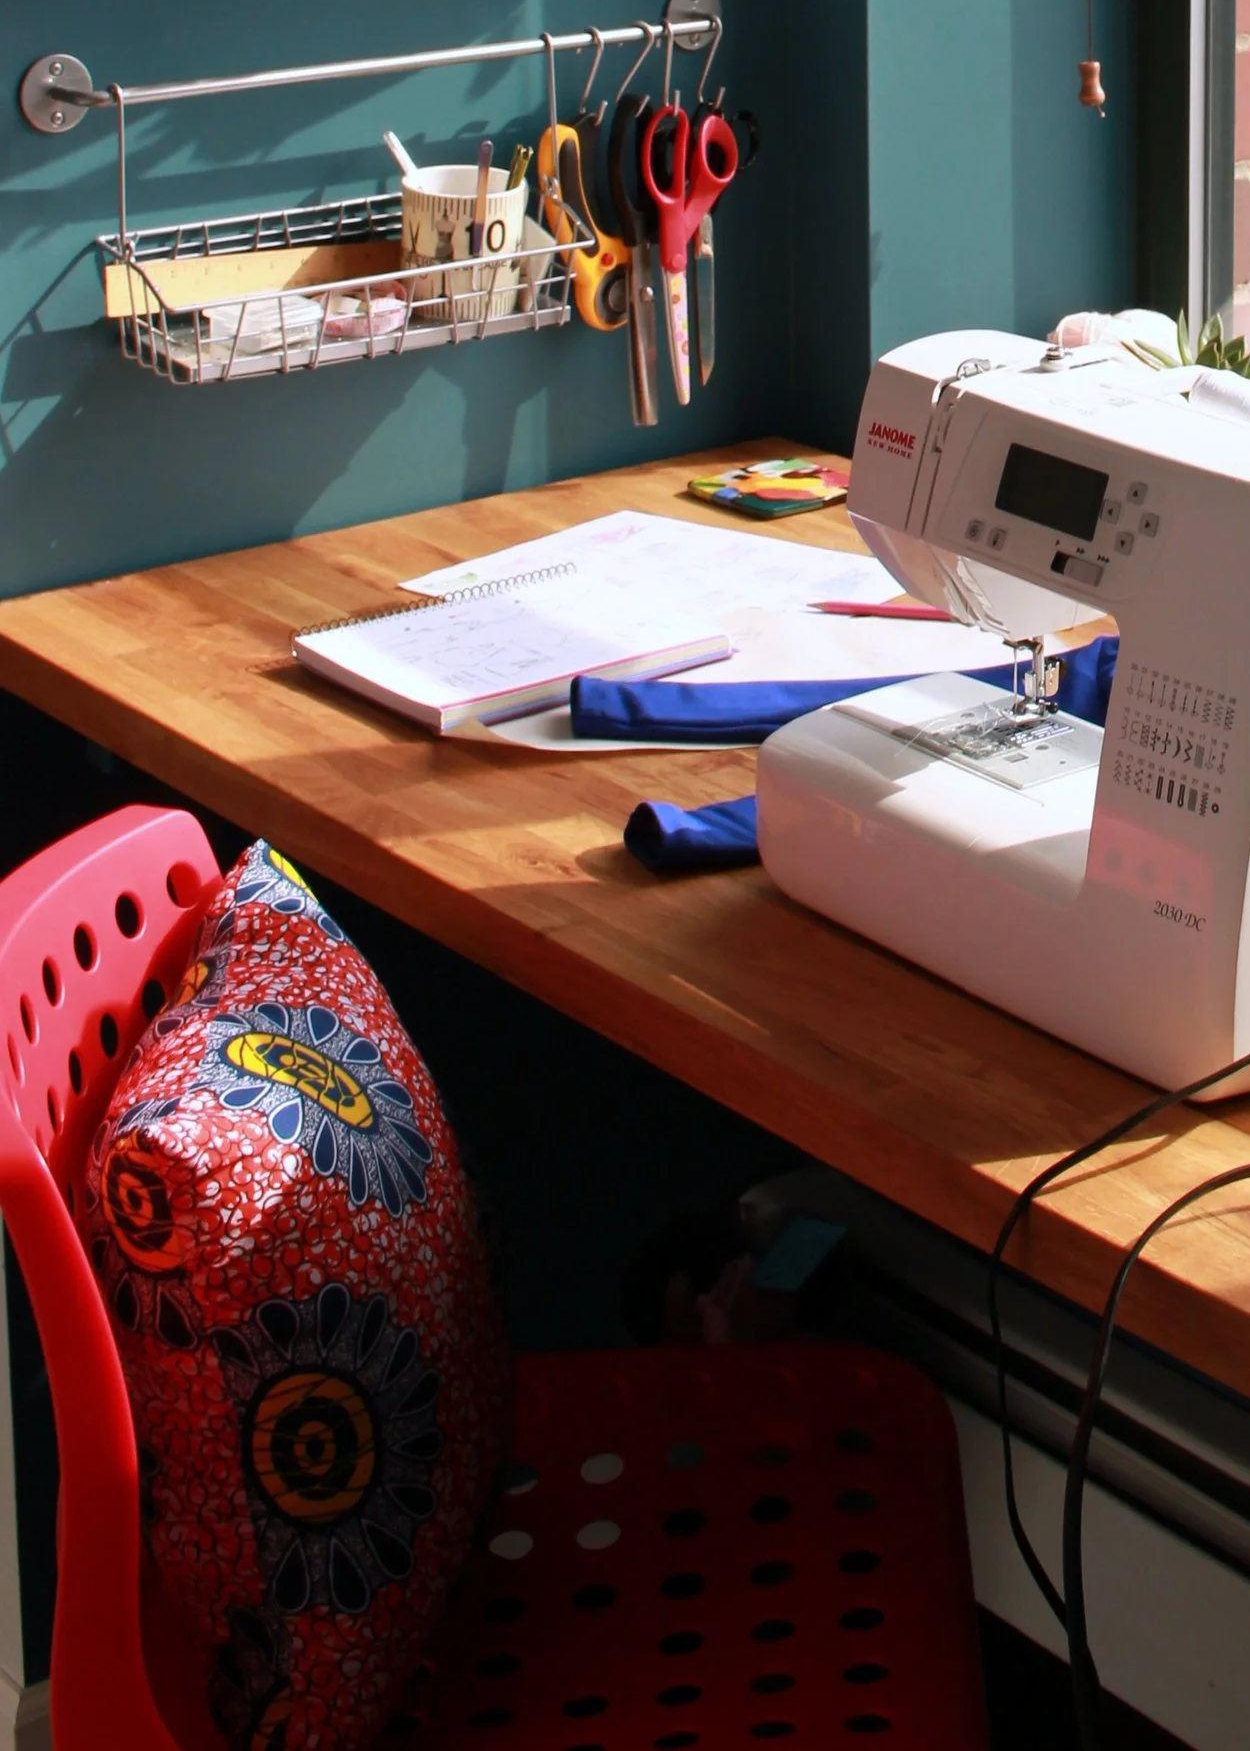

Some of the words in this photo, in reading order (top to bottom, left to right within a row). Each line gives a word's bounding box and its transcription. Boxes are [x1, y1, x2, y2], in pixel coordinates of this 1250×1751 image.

[867, 438, 885, 449] NEW
[887, 445, 912, 459] HOME
[868, 422, 916, 450] JANOME
[1153, 900, 1183, 923] 2030
[1184, 913, 1206, 932] DC
